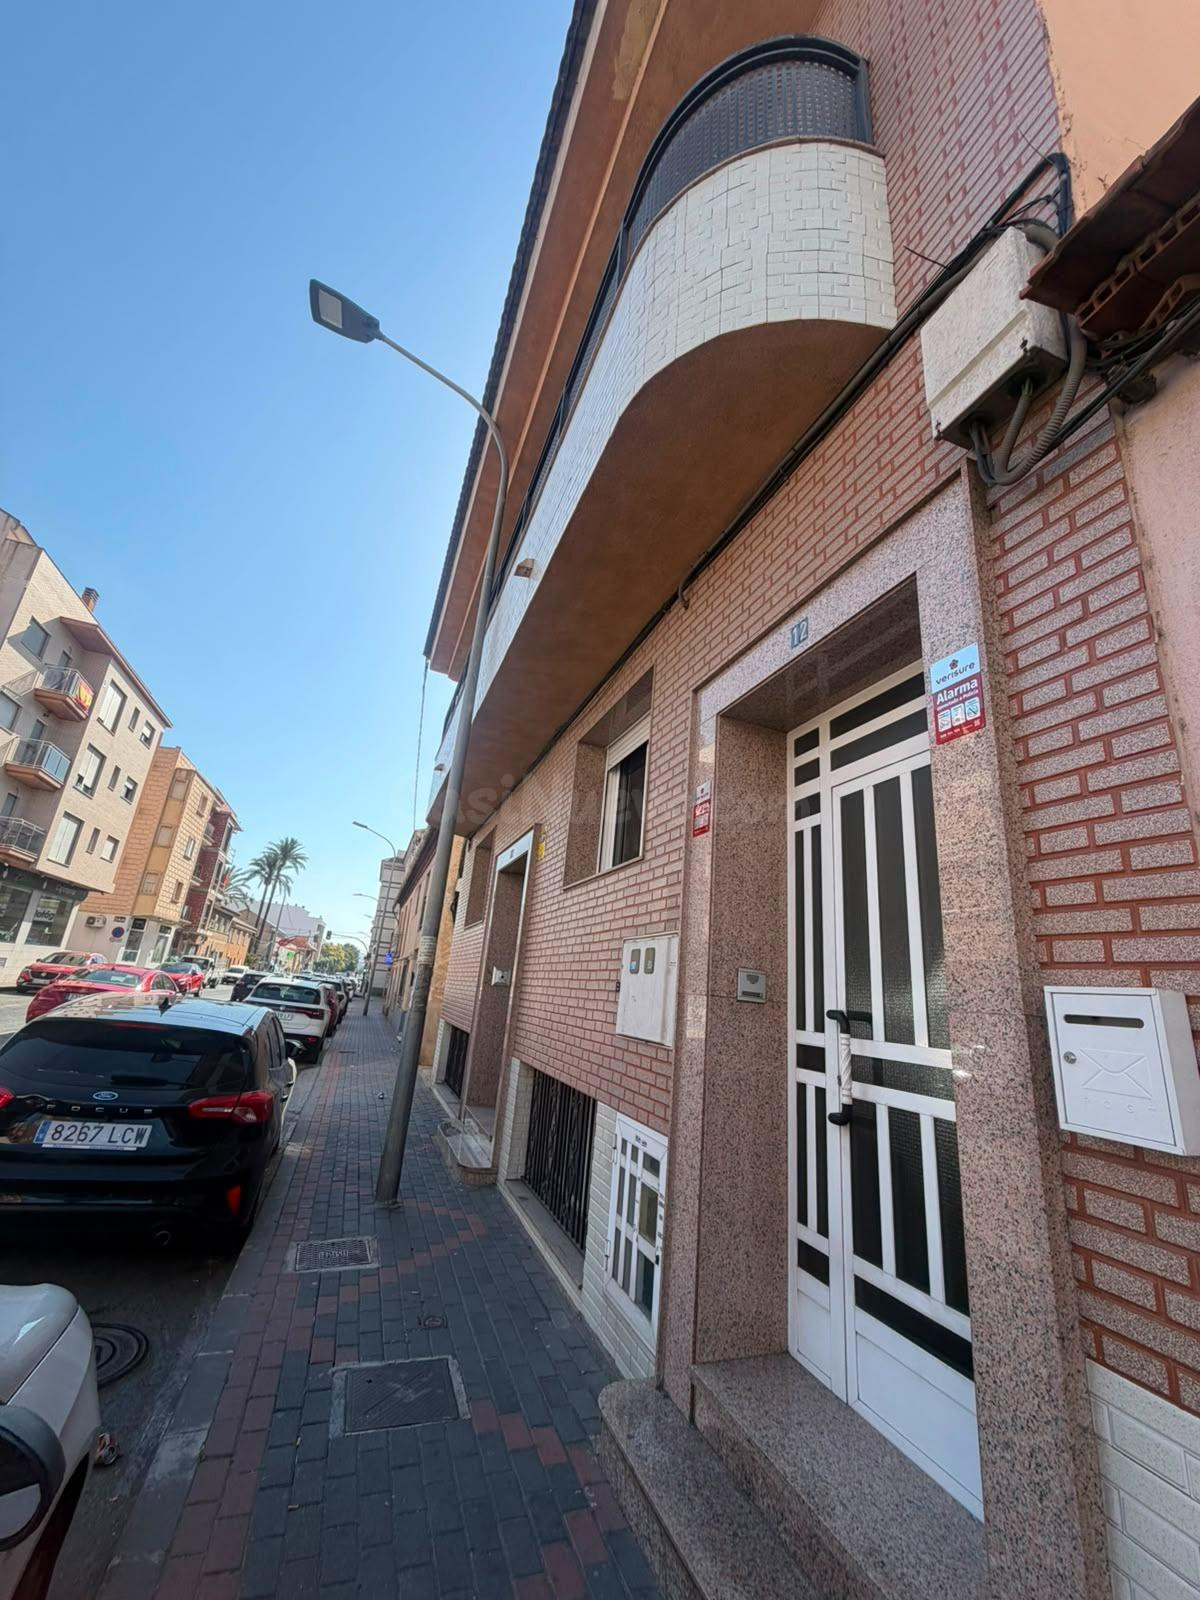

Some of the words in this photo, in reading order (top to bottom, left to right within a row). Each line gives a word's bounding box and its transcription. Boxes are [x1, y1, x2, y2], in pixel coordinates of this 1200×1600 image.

[792, 620, 807, 646] 12
[936, 662, 975, 685] verisure
[937, 679, 978, 705] Alarma
[51, 1124, 104, 1143] 8267
[107, 1127, 148, 1145] LCW
